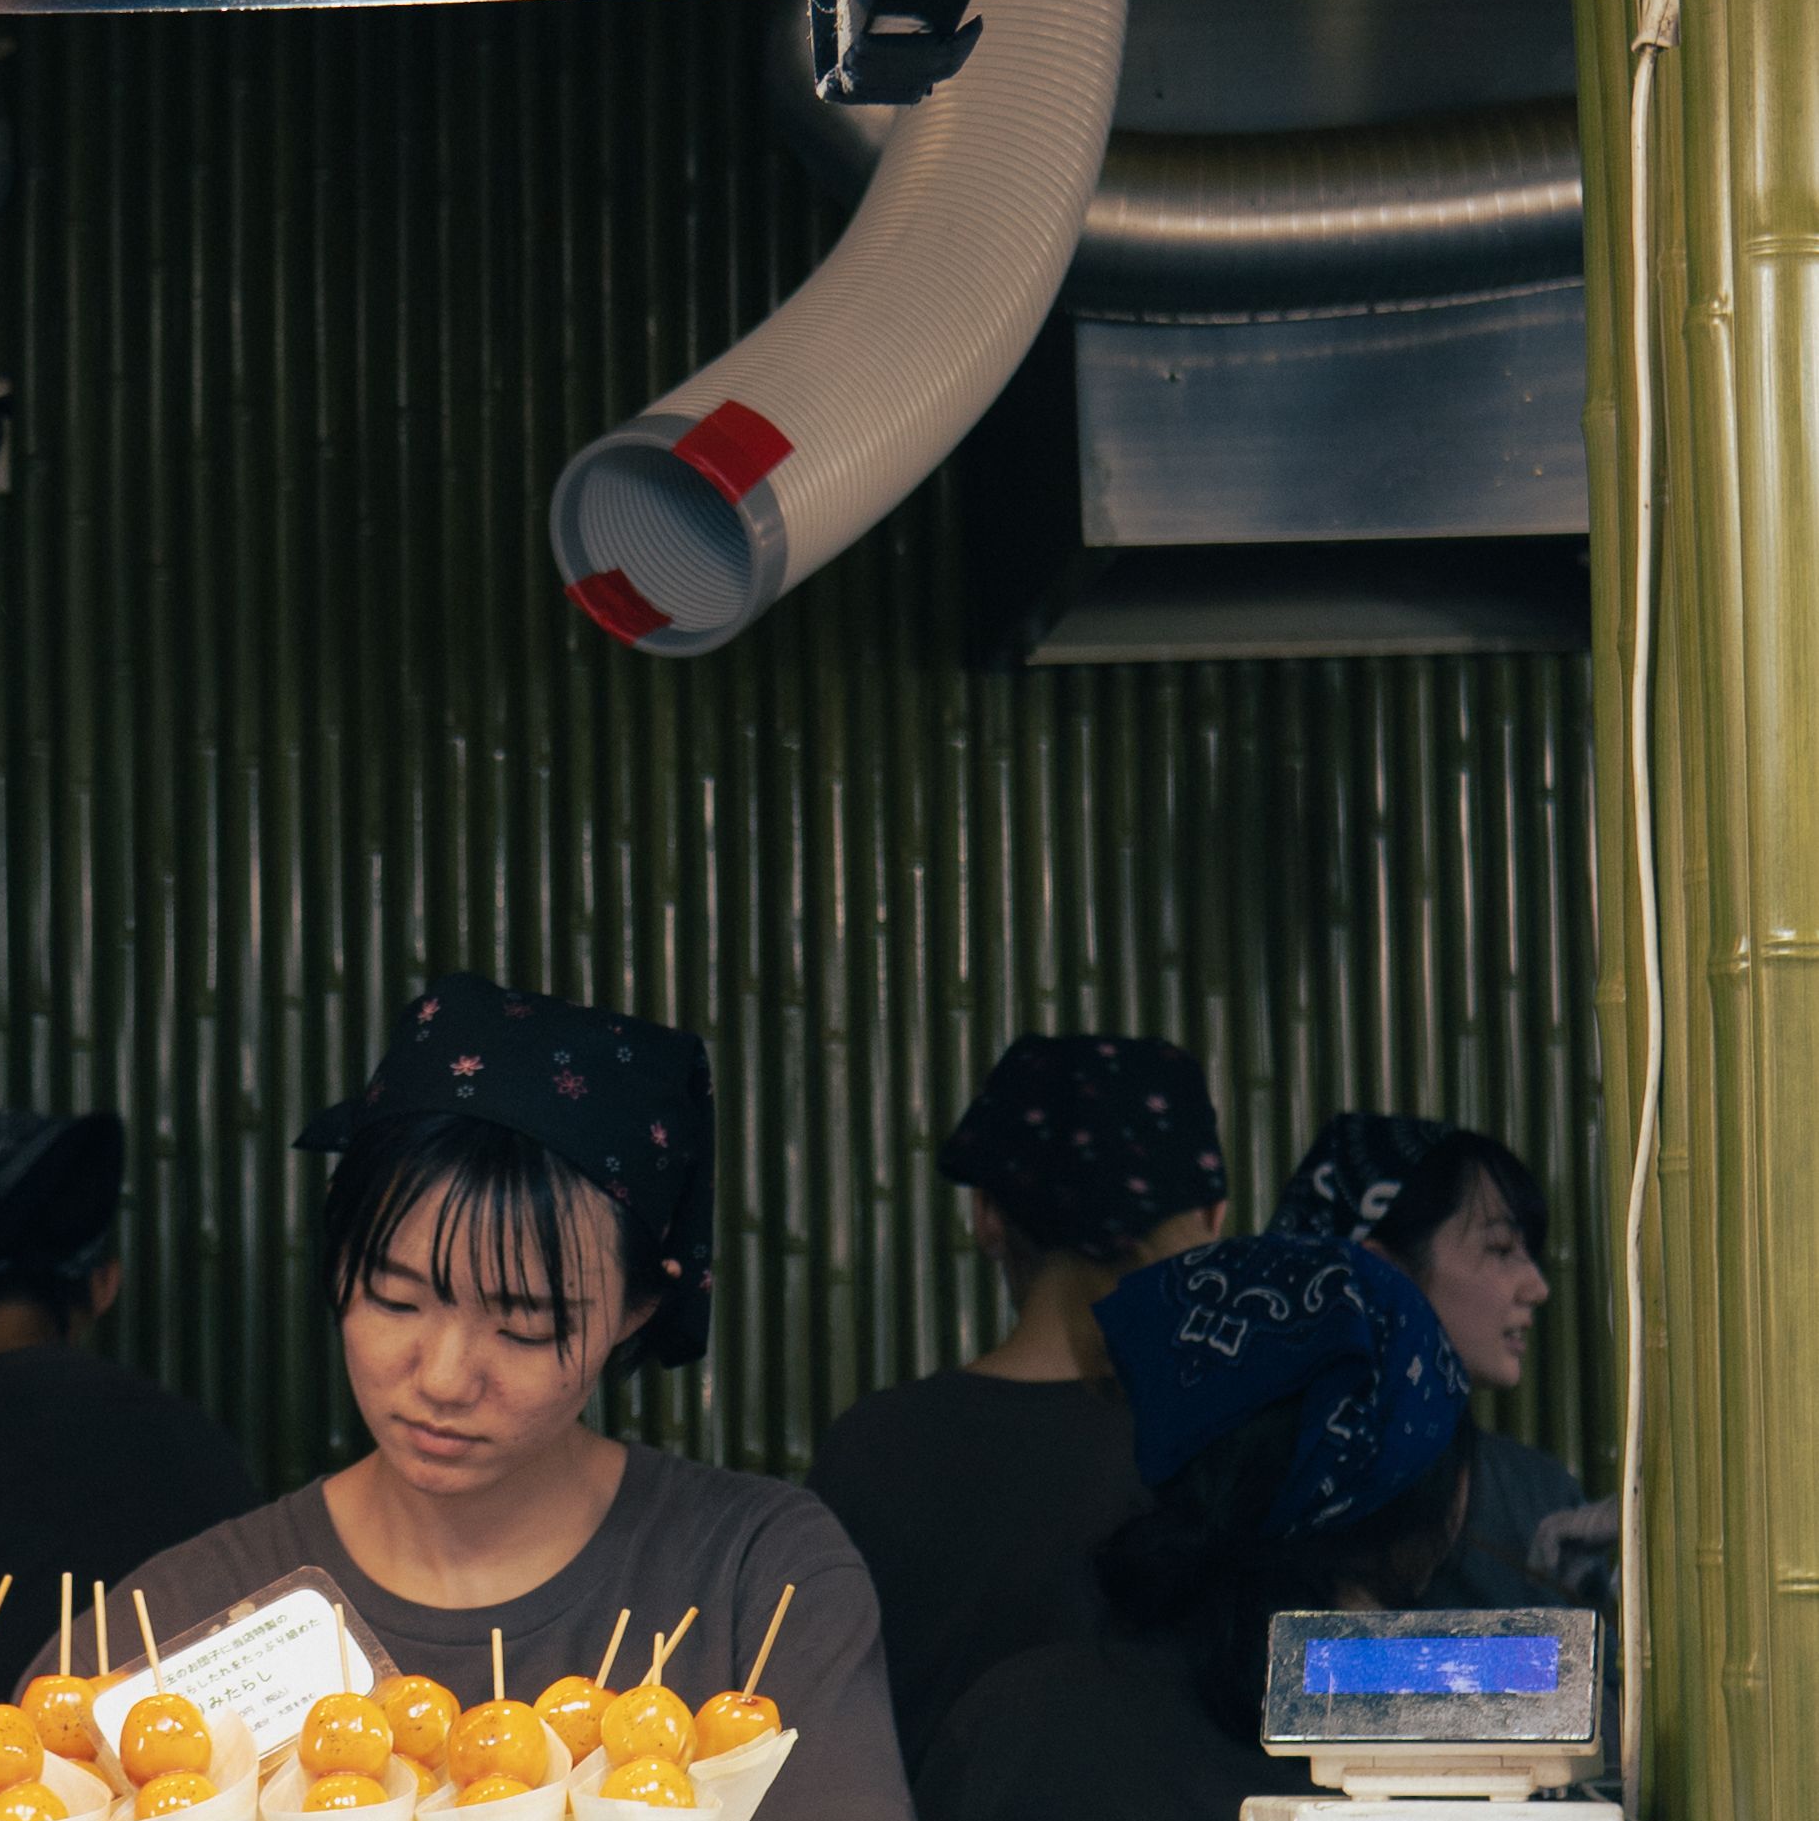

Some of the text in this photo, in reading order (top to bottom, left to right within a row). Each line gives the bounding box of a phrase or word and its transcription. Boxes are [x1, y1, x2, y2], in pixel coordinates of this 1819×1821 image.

[154, 1614, 288, 1689] 玉のお団子に当店特製の
[179, 1618, 320, 1697] らしたれをたっぷり絡めた
